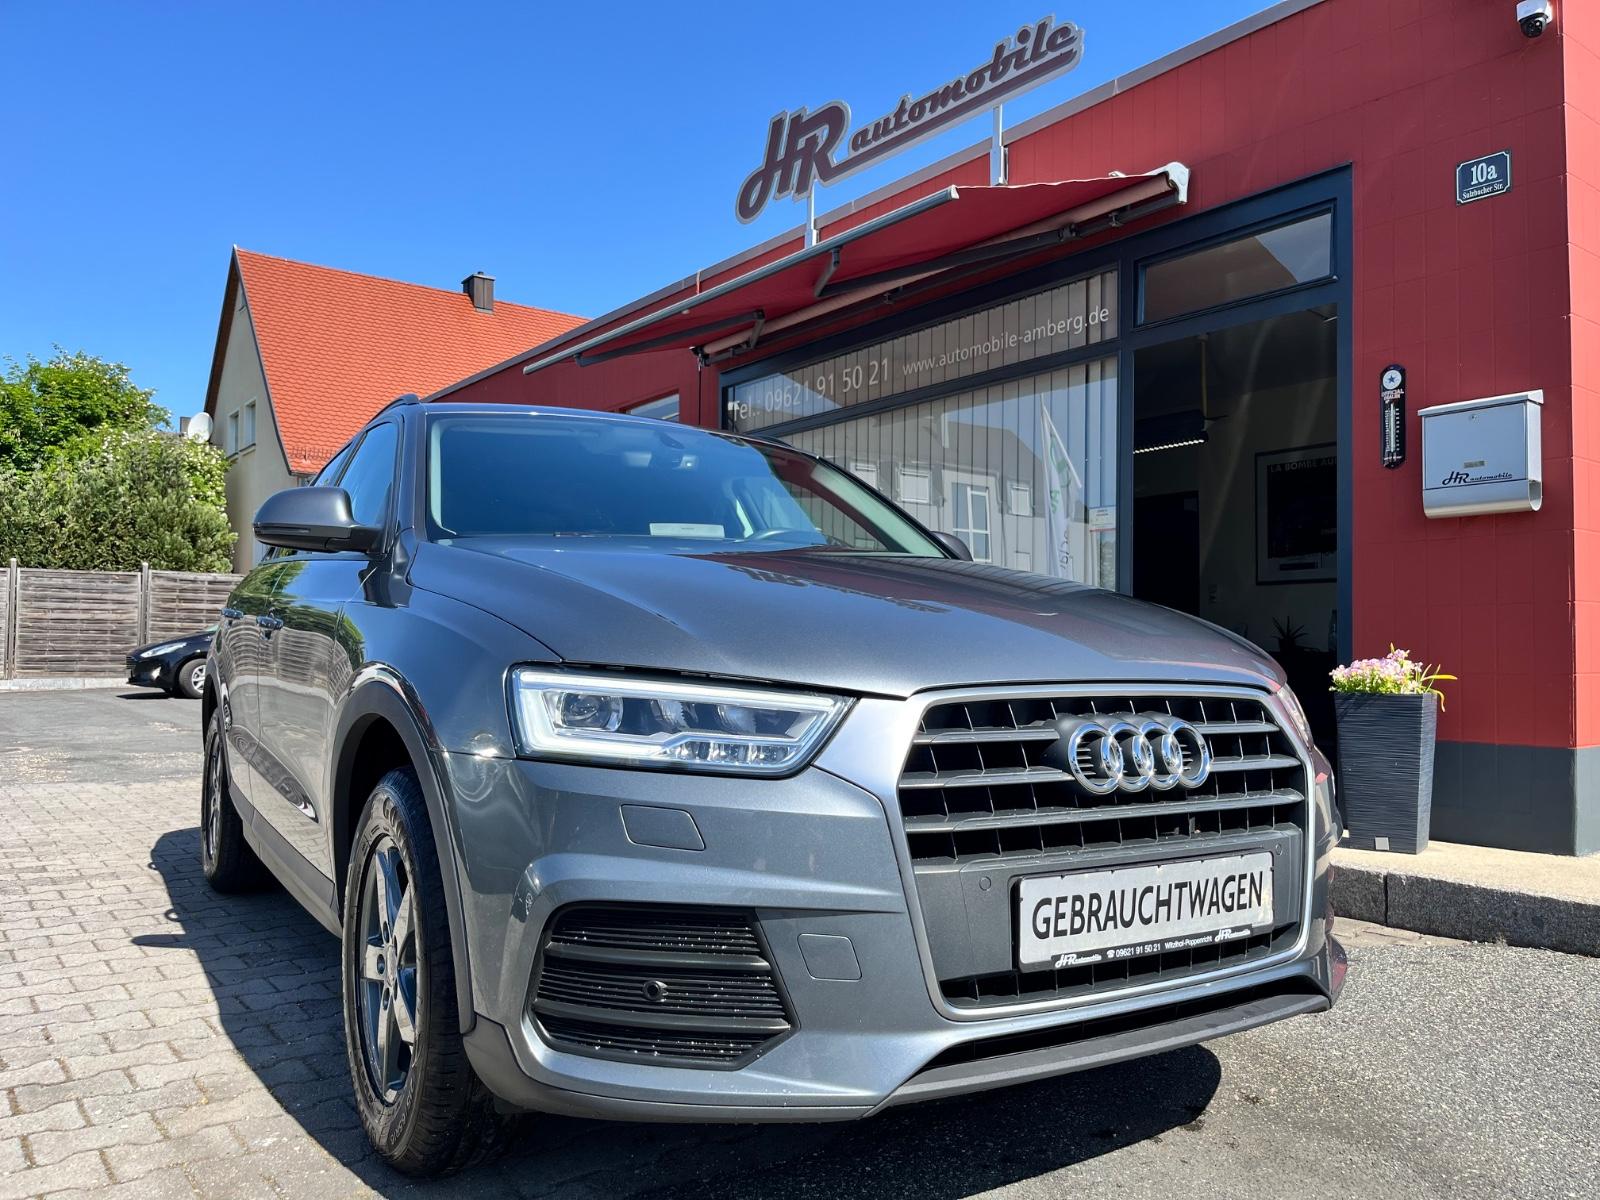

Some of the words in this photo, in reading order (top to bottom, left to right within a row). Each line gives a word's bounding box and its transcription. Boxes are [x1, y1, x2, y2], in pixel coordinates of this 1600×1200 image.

[737, 102, 850, 221] HR
[850, 19, 1079, 153] automobile
[1470, 162, 1498, 185] 10a
[1493, 182, 1504, 191] Str.
[764, 379, 810, 413] 09621
[816, 372, 835, 400] 91
[842, 364, 863, 393] 50
[868, 357, 889, 386] 21
[902, 304, 1110, 376] www.automobile-amberg.de
[1441, 470, 1470, 486] HR
[1031, 870, 1264, 940] GEBRAUCHTWAGEN
[1115, 948, 1134, 958] 09621
[1135, 946, 1143, 955] 91
[1144, 944, 1153, 953] 50
[1153, 943, 1161, 952] 21
